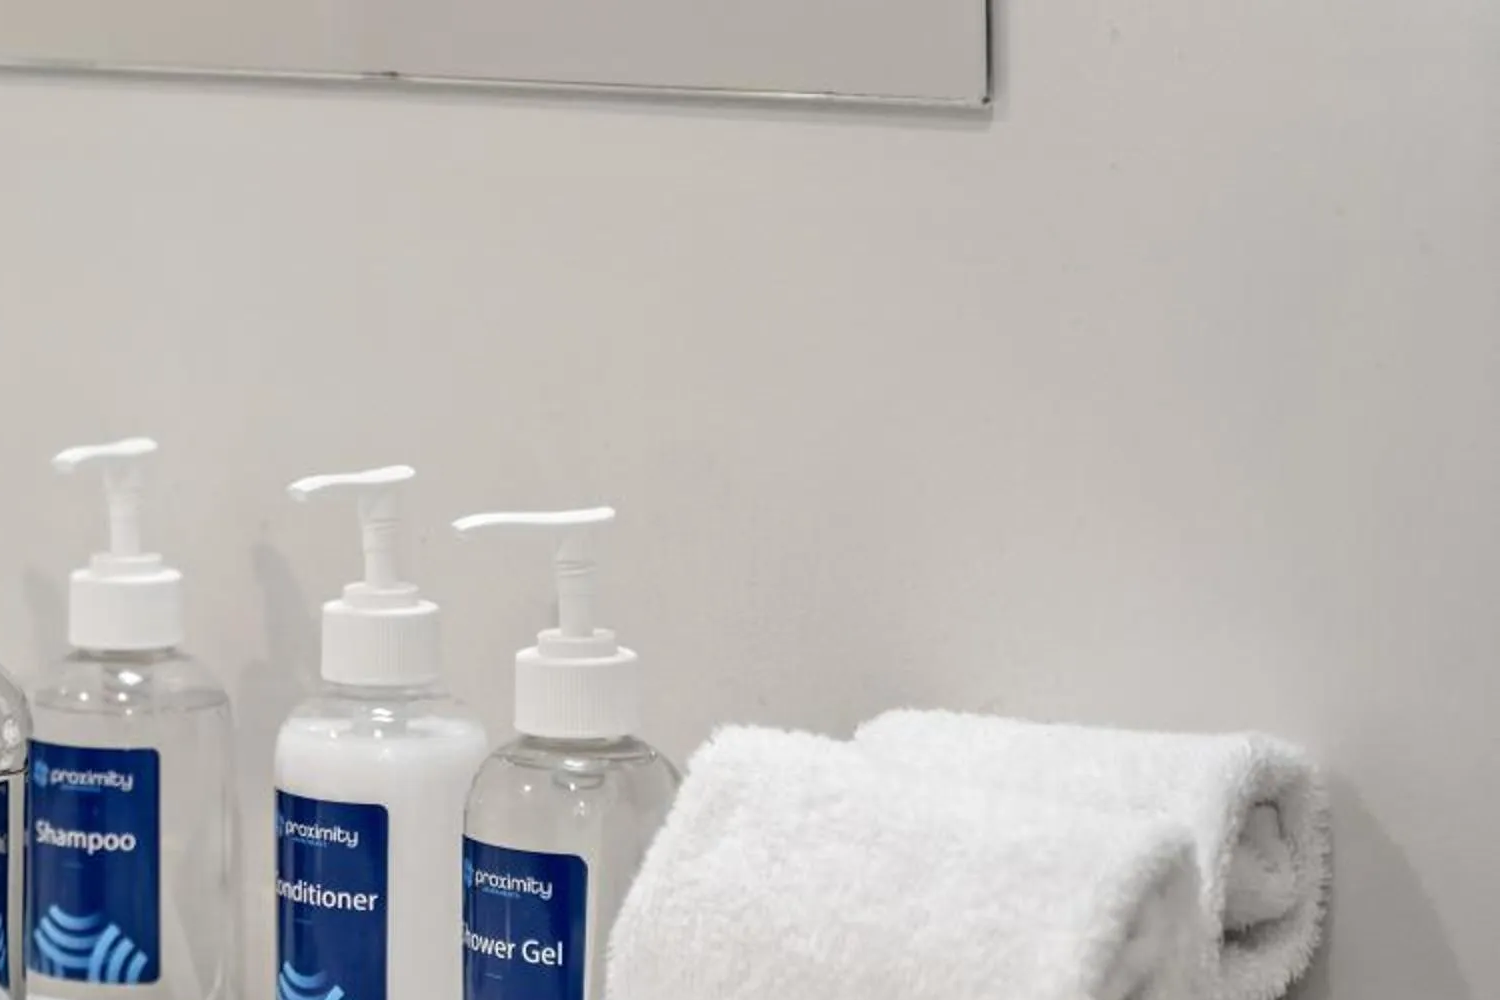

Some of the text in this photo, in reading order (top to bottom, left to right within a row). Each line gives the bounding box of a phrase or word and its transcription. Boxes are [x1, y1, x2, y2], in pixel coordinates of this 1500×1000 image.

[51, 768, 133, 792] proximity
[35, 820, 136, 855] Shampoo
[285, 821, 359, 848] proximity
[276, 879, 379, 911] onditioner
[475, 869, 552, 900] proximity
[463, 922, 563, 966] hower Gel
